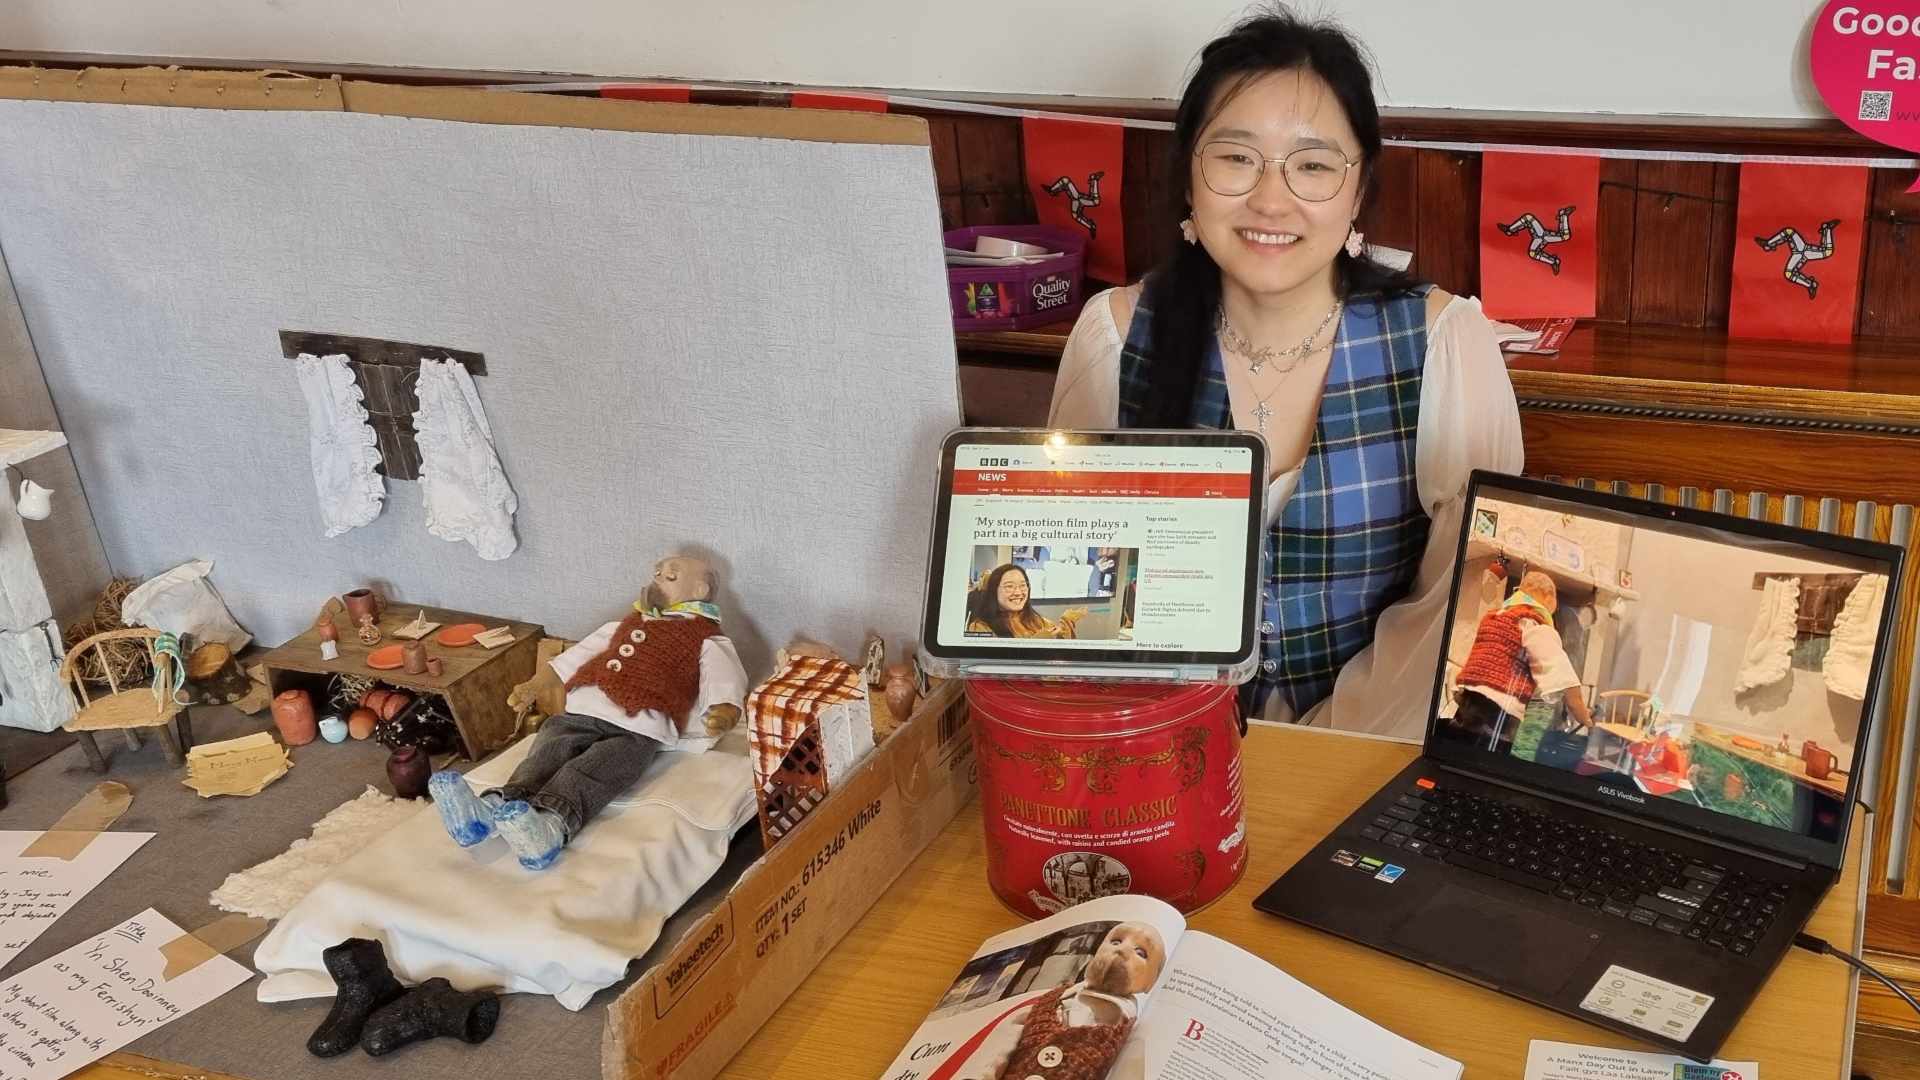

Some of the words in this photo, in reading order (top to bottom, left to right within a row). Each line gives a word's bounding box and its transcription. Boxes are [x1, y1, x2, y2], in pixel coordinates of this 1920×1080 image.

[1867, 50, 1920, 80] Fa
[1032, 279, 1071, 298] Quality
[1036, 294, 1068, 310] Street
[980, 458, 1008, 466] BBC
[978, 473, 1007, 481] NEWS
[997, 518, 1063, 528] stop-motion
[1066, 518, 1088, 528] film
[1091, 519, 1120, 530] plays
[973, 529, 997, 539] part
[999, 530, 1009, 538] in
[1021, 530, 1038, 541] big
[1040, 530, 1083, 540] cultural
[1598, 785, 1616, 796] ASUS
[1617, 790, 1645, 803] Vivobook
[1001, 792, 1090, 828] PANETTONE
[1103, 794, 1177, 827] CLASSIC
[1057, 838, 1070, 846] with
[1093, 839, 1105, 847] and
[1106, 836, 1131, 847] candied
[1132, 834, 1154, 843] orange
[1154, 829, 1170, 840] peels
[1129, 827, 1153, 836] arancia
[755, 902, 779, 934] ITEM
[802, 831, 845, 887] 615346
[847, 799, 881, 841] White
[756, 928, 781, 958] QTY:
[781, 912, 789, 935] 1
[791, 897, 808, 924] SET
[3, 939, 28, 949] set
[665, 923, 724, 989] Yaheetech
[53, 962, 70, 973] as
[5, 984, 23, 1004] My
[1184, 1018, 1205, 1040] B
[910, 1041, 952, 1060] Cum
[1578, 1053, 1625, 1064] Welcome
[1557, 1058, 1583, 1066] Manx
[1586, 1061, 1605, 1070] Day
[1641, 1067, 1671, 1077] Laxey
